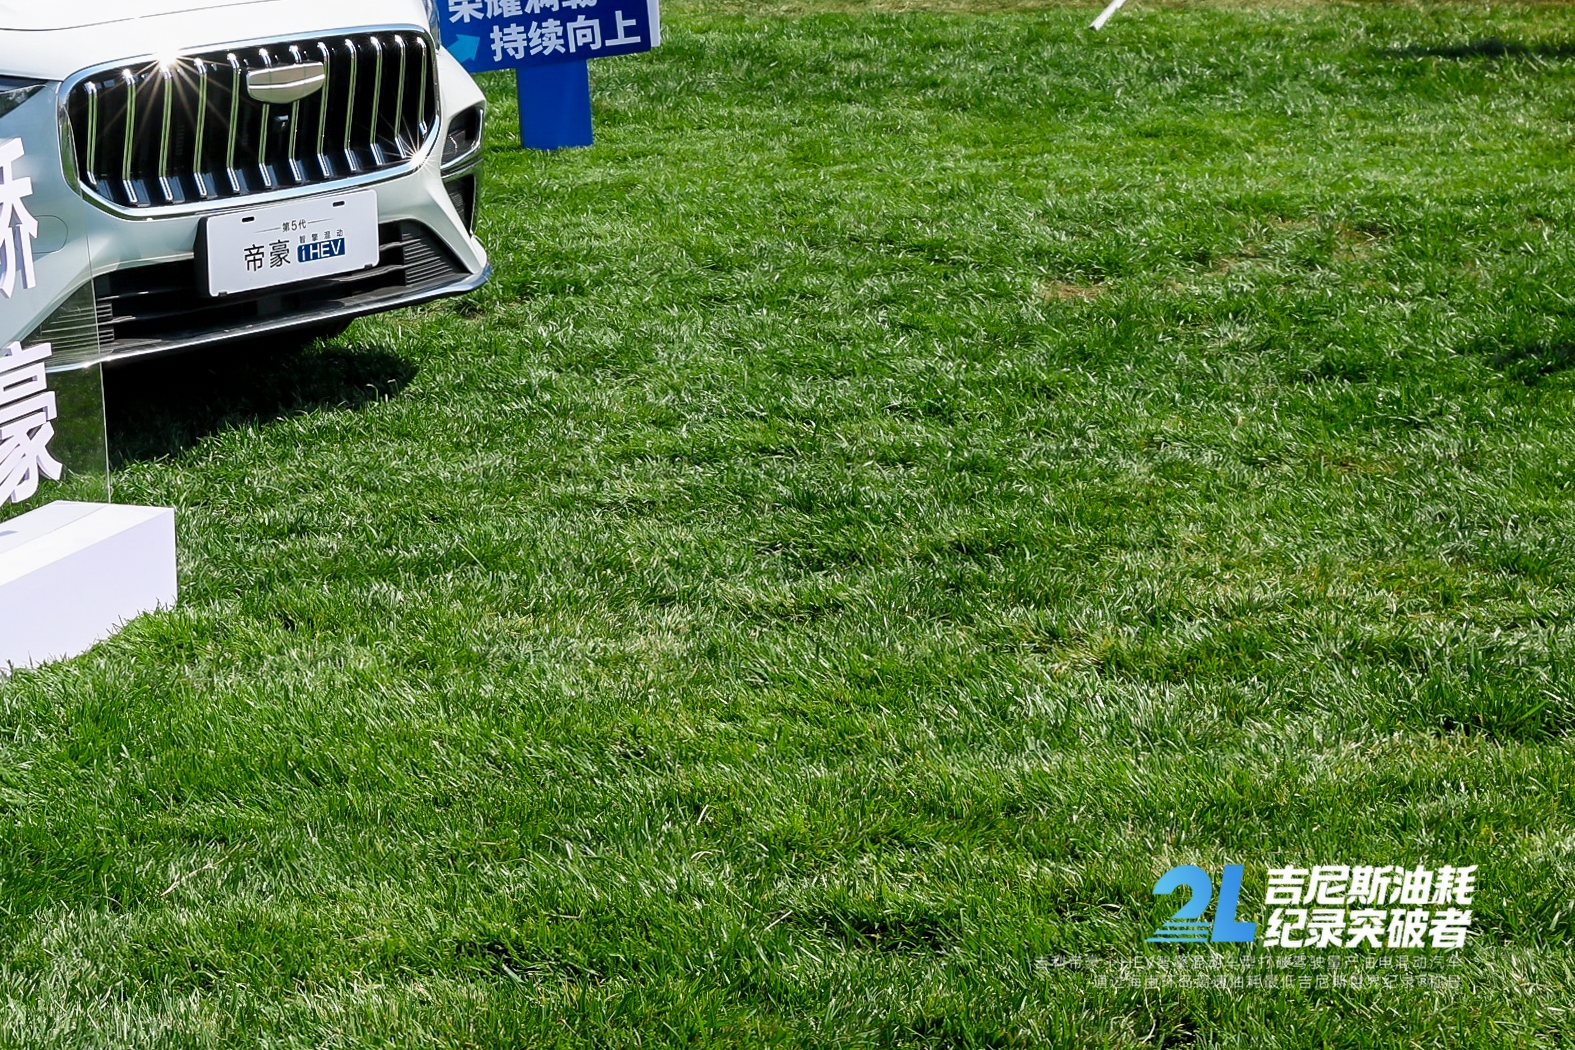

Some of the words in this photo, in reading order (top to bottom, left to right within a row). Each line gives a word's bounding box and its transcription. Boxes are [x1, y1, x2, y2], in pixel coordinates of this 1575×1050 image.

[489, 11, 642, 62] 持续向上
[281, 219, 307, 233] 第5代
[243, 239, 292, 272] 帝豪
